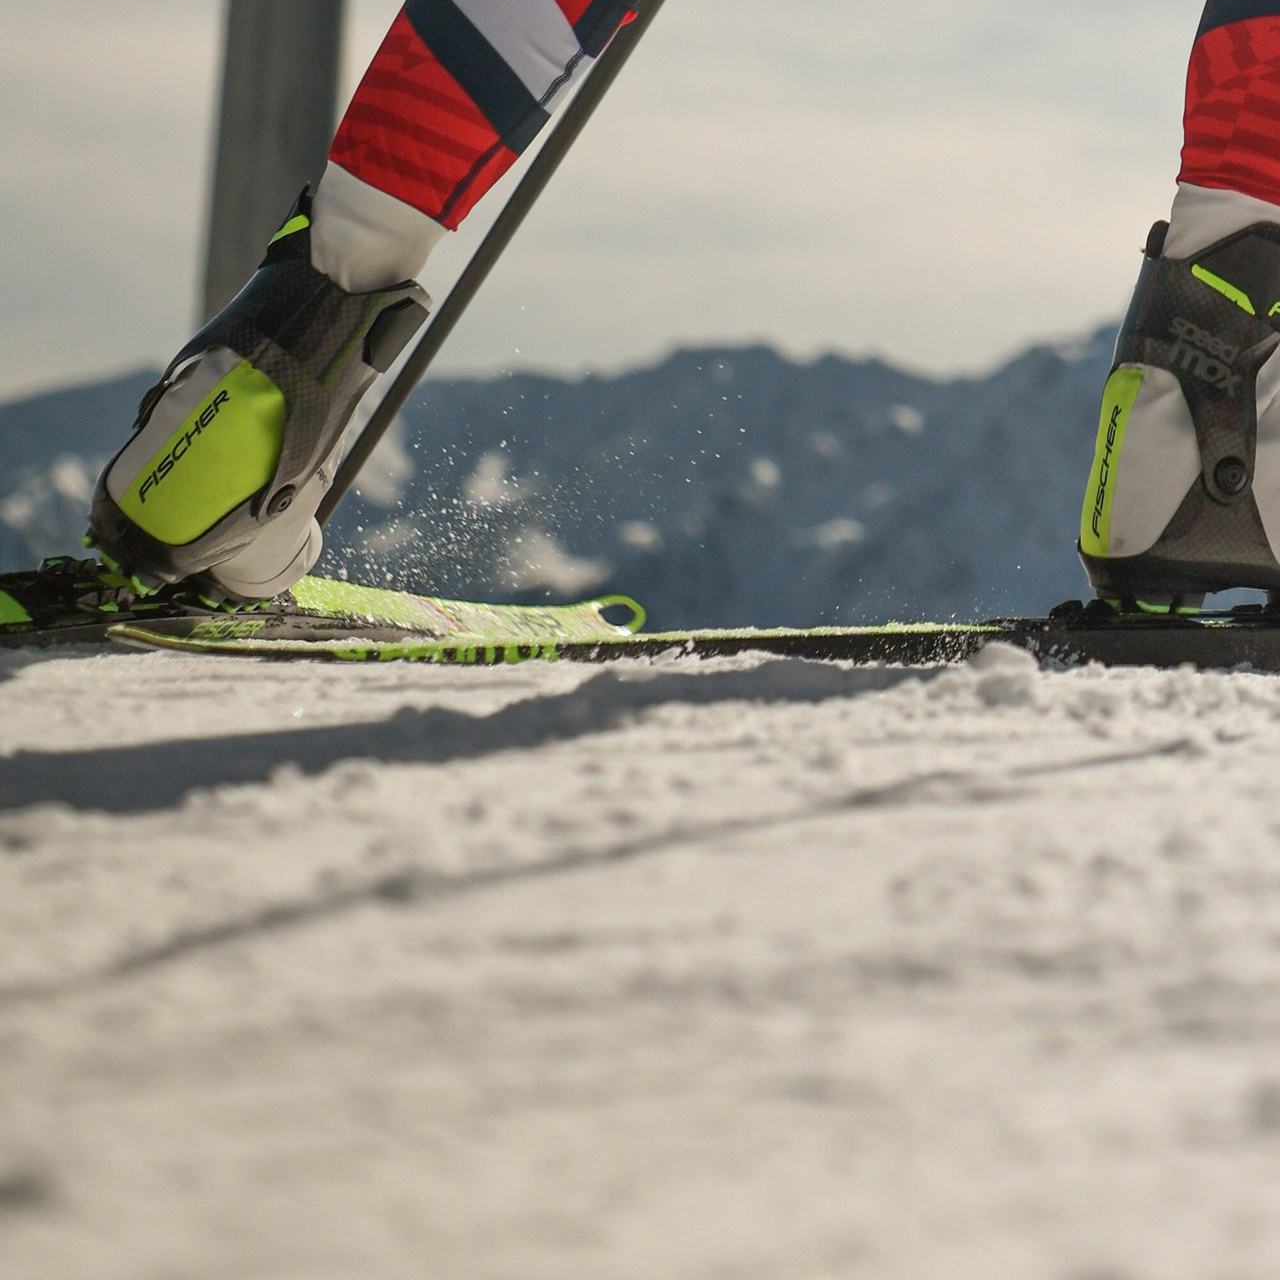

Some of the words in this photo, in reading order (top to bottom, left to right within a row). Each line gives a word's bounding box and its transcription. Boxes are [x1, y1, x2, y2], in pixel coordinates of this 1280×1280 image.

[139, 389, 231, 504] FISCHER
[1091, 405, 1122, 538] FISCHER
[184, 620, 266, 640] FISCHER
